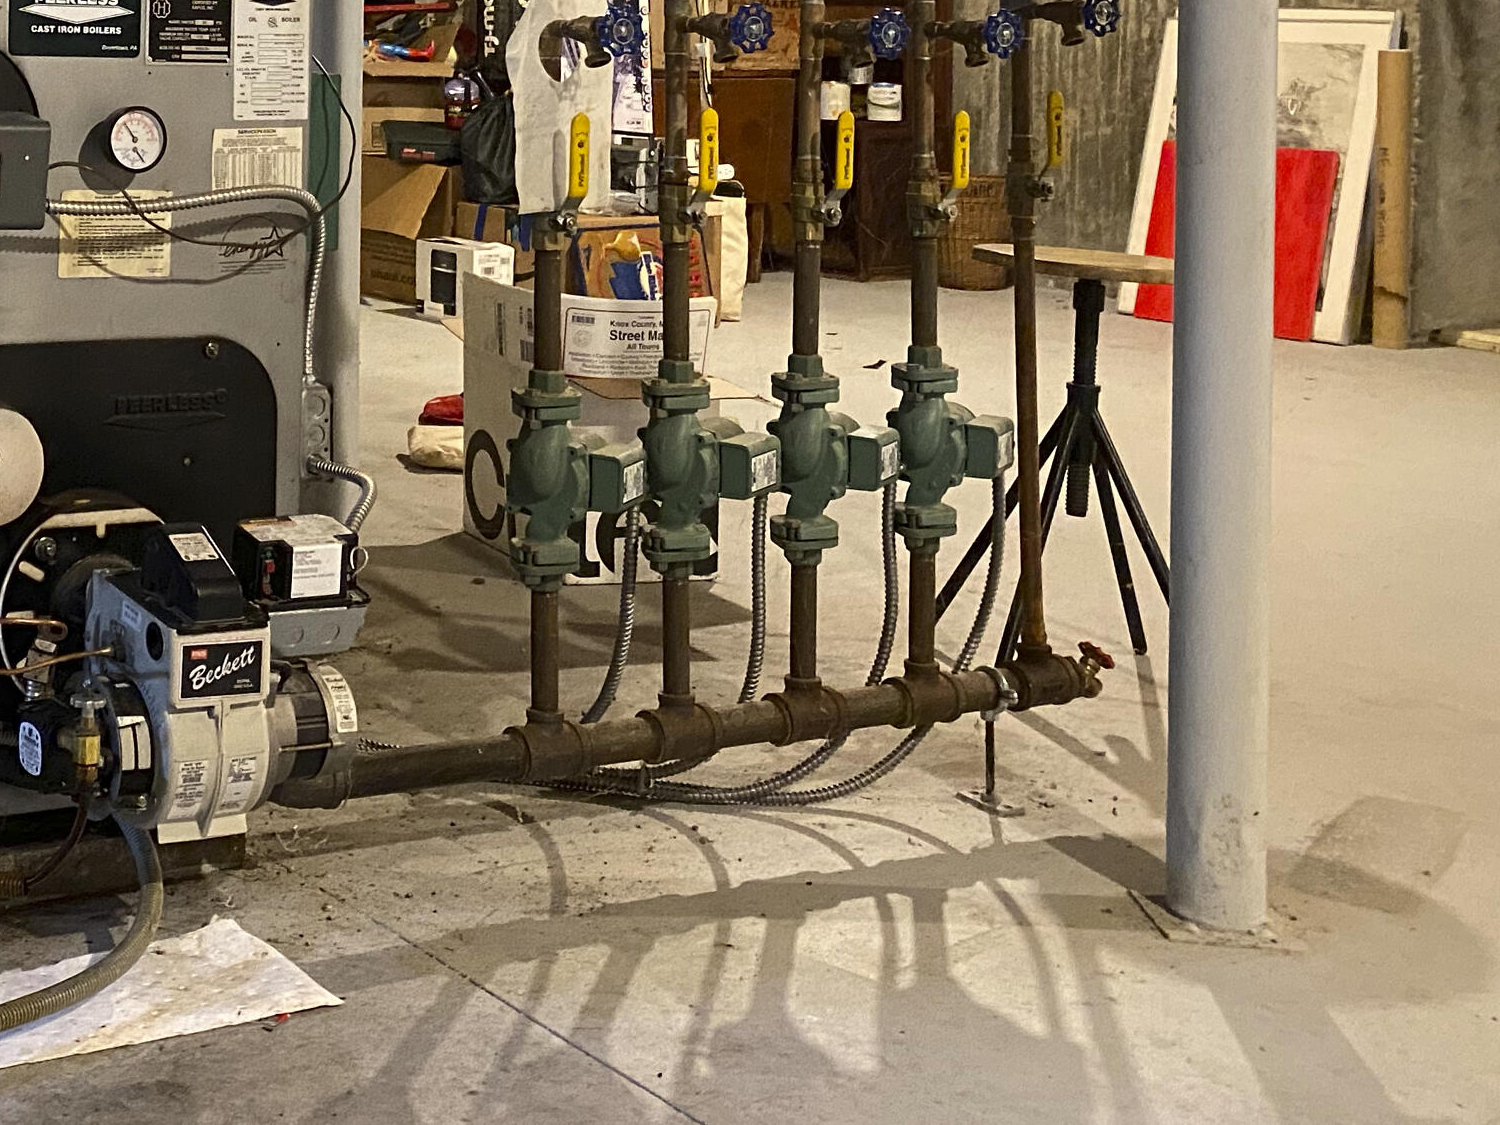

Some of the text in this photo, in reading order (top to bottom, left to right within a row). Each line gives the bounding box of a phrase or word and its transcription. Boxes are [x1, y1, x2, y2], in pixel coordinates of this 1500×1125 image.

[31, 24, 122, 35] CAST IRON BOILERS
[610, 329, 664, 342] Street Ma
[189, 645, 256, 690] Beckett
